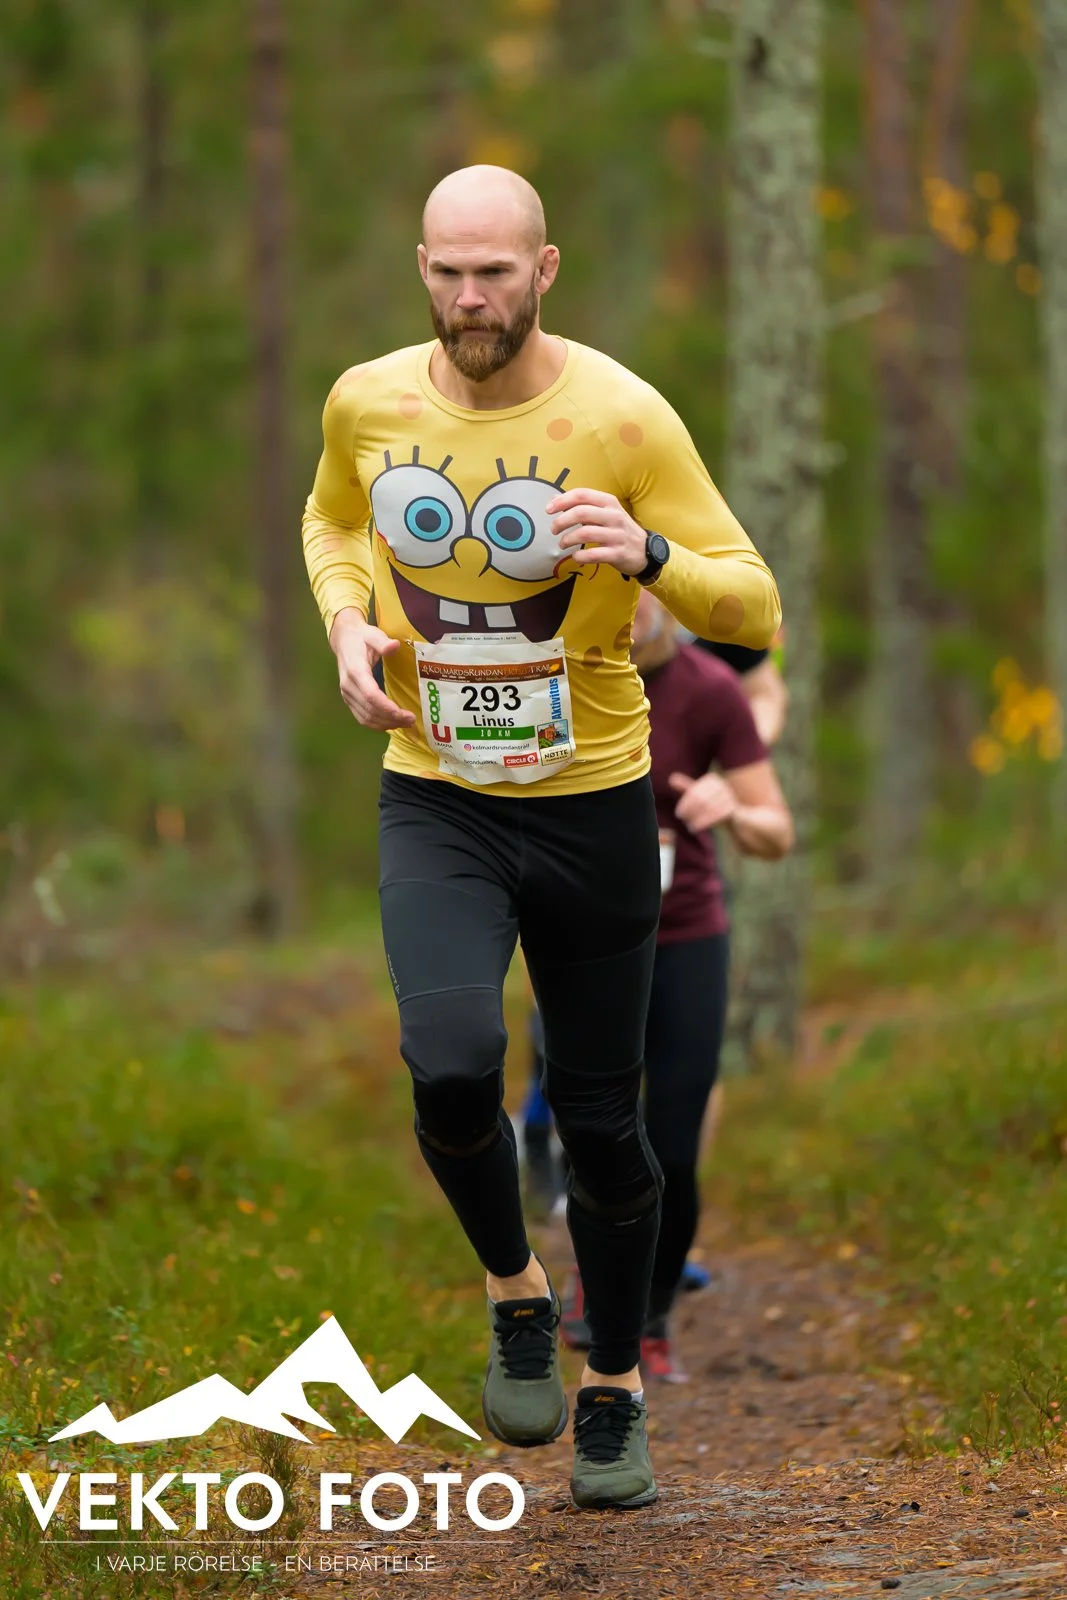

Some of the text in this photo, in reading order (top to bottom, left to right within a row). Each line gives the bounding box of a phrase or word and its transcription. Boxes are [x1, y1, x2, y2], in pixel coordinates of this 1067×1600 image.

[427, 681, 440, 724] coop
[461, 685, 521, 712] 293
[549, 677, 562, 720] Aktivitus
[473, 715, 514, 727] Linus
[480, 729, 511, 737] 10 KM
[506, 757, 527, 765] CIRCLE
